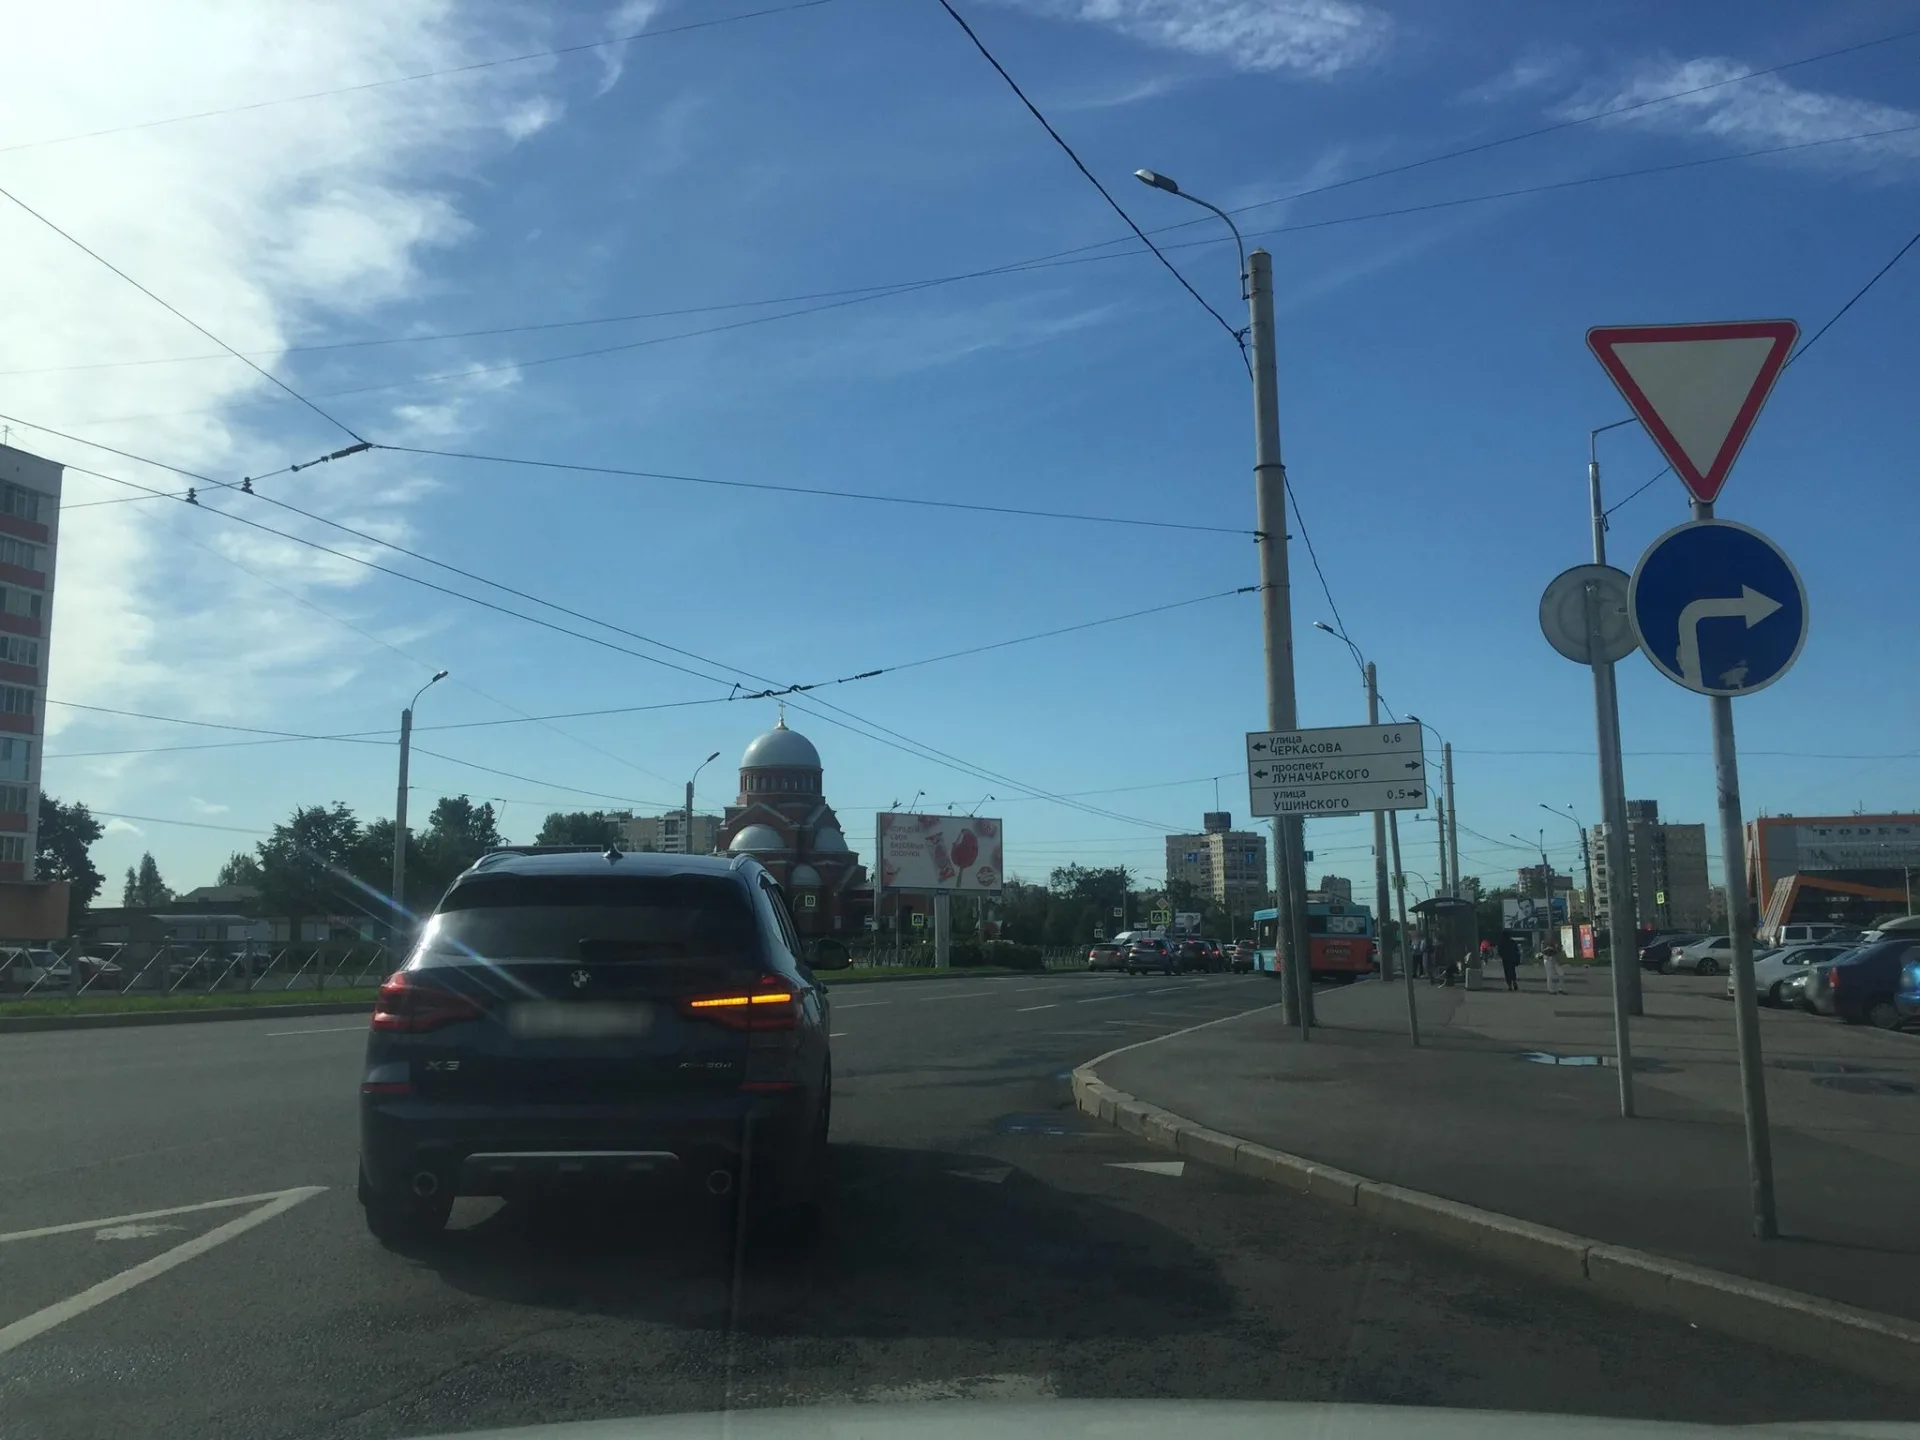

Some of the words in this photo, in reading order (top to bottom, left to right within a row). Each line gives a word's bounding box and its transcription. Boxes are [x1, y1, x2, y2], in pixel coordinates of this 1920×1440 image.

[1269, 735, 1302, 747] улица
[1382, 733, 1402, 744] 0.6
[1270, 742, 1342, 756] ЧЕРКАСОВА
[1271, 761, 1324, 774] проспект
[1272, 768, 1370, 784] ЛУНАЧАРСКОГО
[1273, 789, 1306, 801] улица
[1387, 788, 1405, 800] 0.5
[1274, 798, 1349, 812] УШИНСКОГО
[425, 1060, 461, 1071] X3
